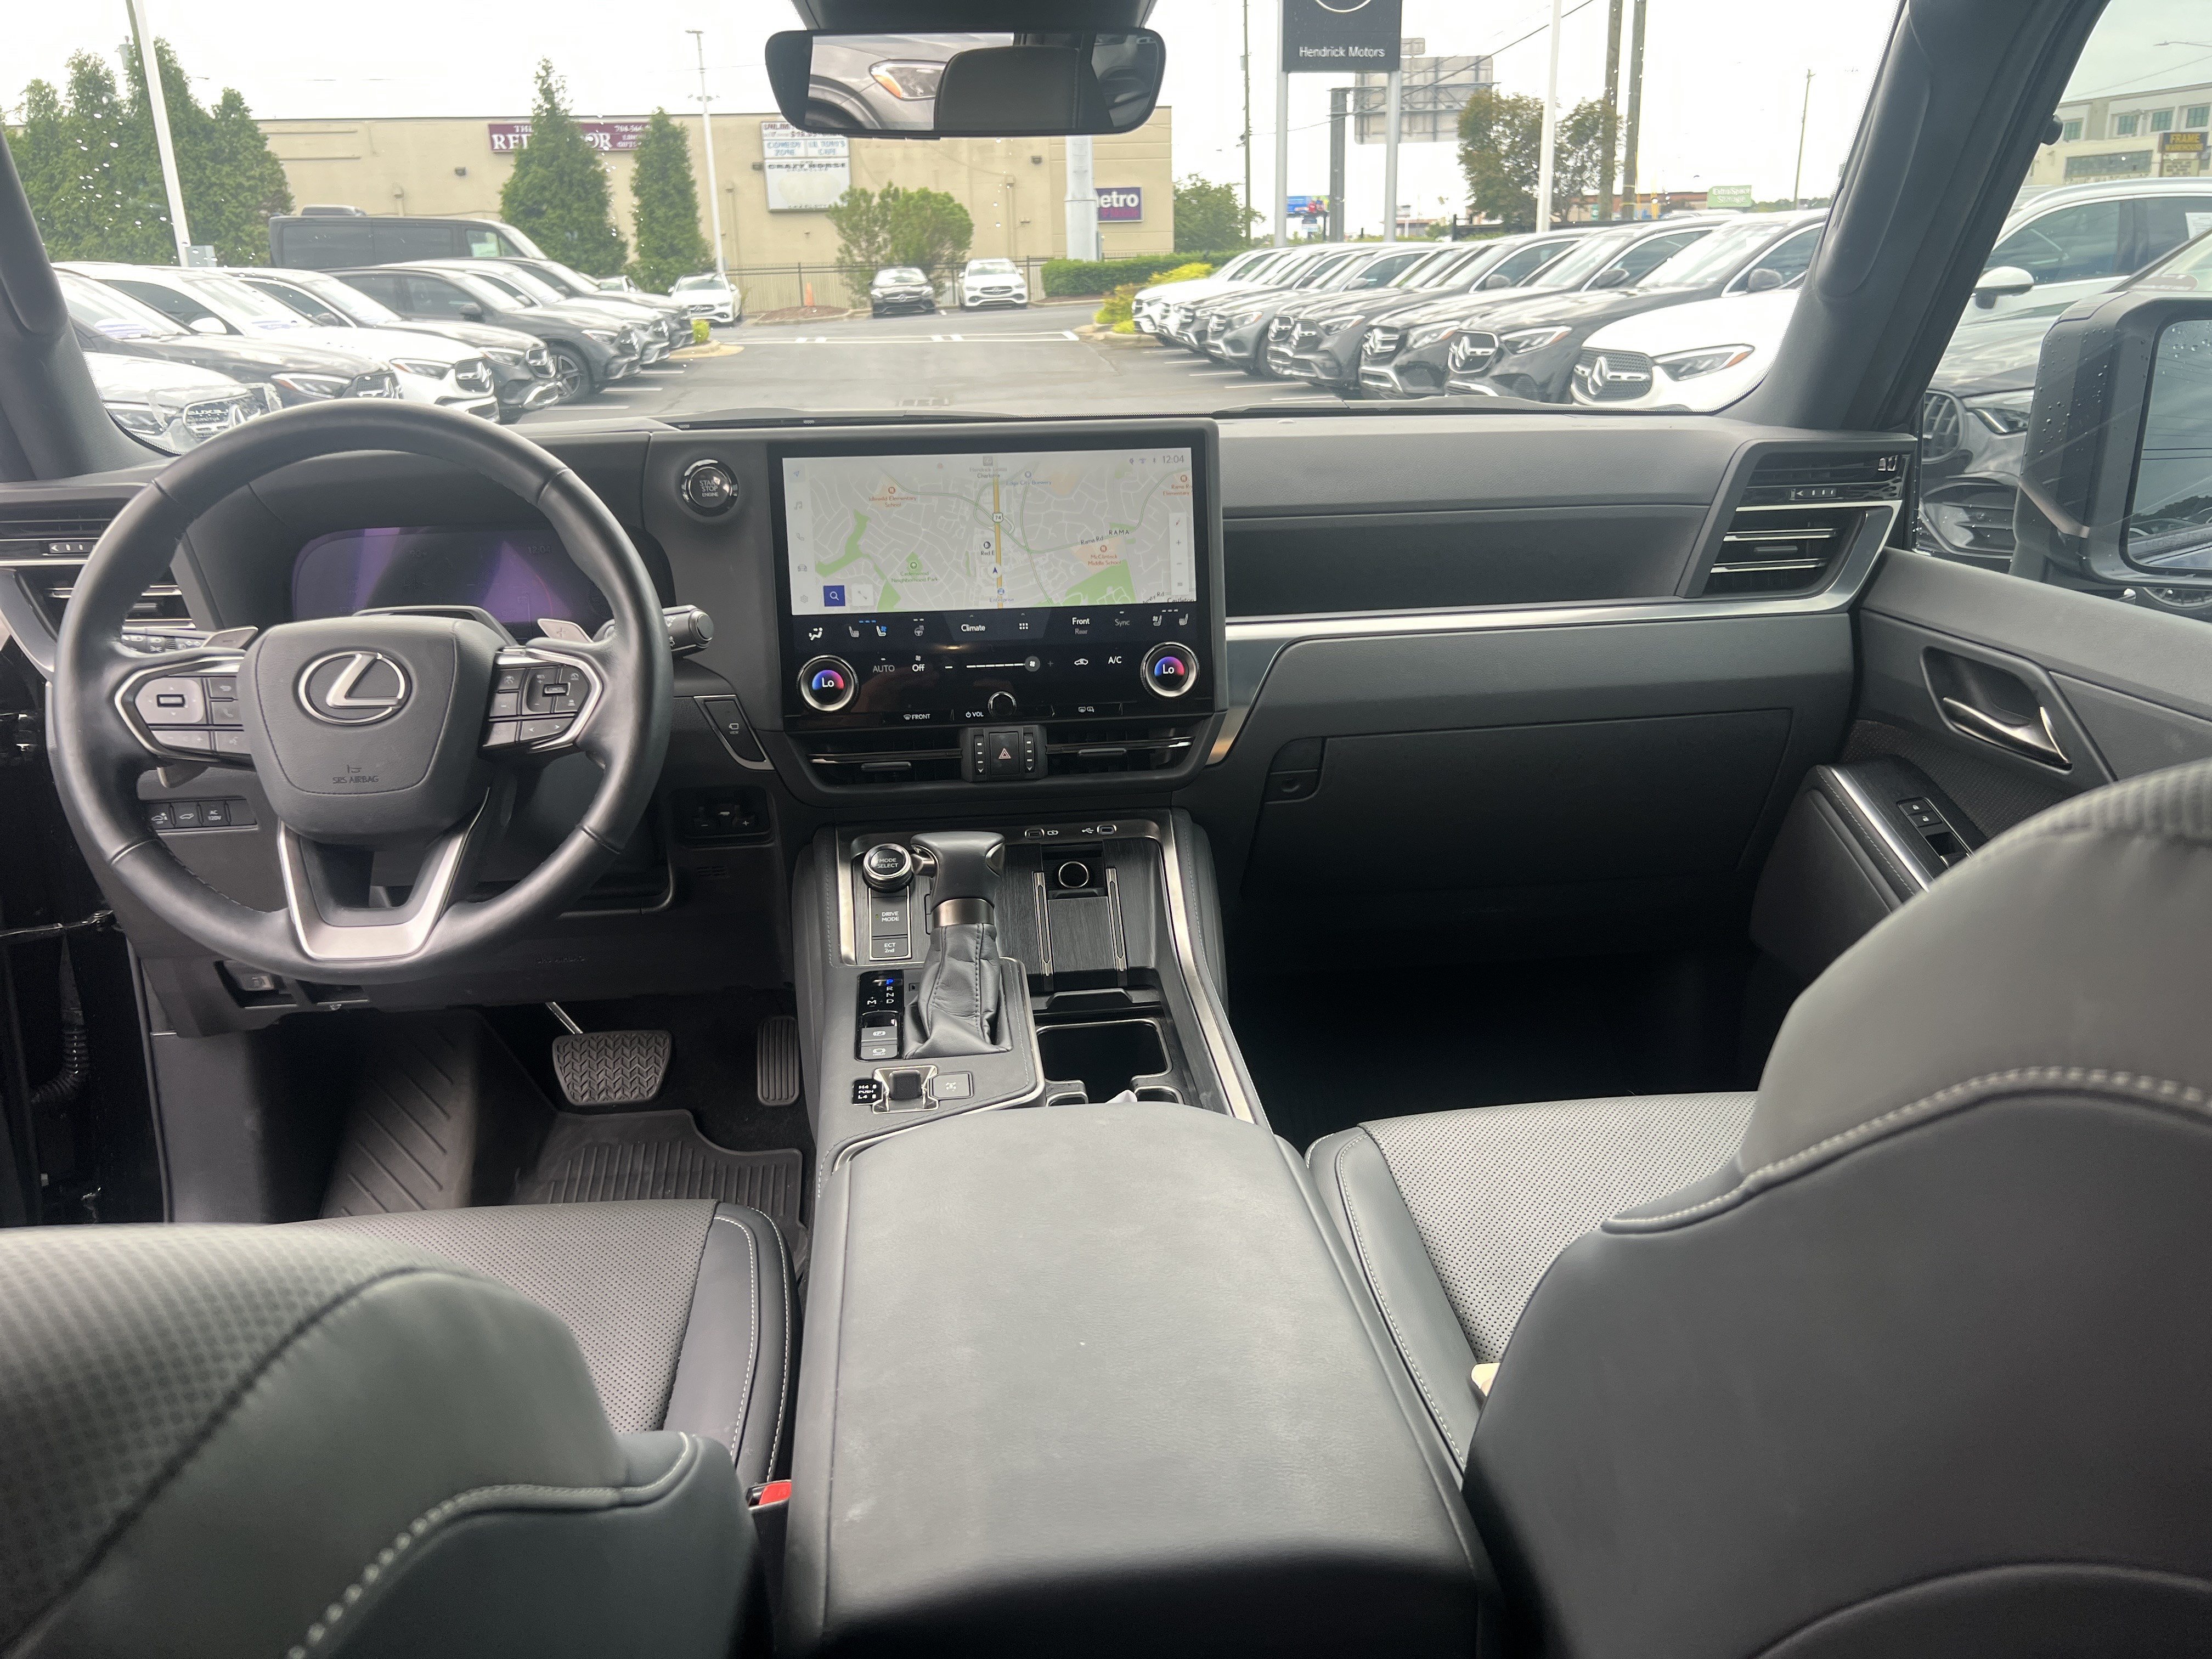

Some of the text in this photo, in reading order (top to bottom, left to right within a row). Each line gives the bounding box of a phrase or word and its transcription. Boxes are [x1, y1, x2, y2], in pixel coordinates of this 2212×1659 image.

[1299, 46, 1386, 58] Hendrick Motors
[1163, 455, 1184, 464] 12:04
[1072, 617, 1090, 625] Front
[1114, 618, 1131, 628] Sync
[961, 623, 986, 632] Climate
[1108, 656, 1122, 664] A/C
[872, 665, 895, 673] AUTO
[912, 664, 925, 672] Off
[1162, 663, 1175, 674] Lo
[822, 677, 834, 688] Lo
[332, 775, 379, 785] SRS AIRBAG
